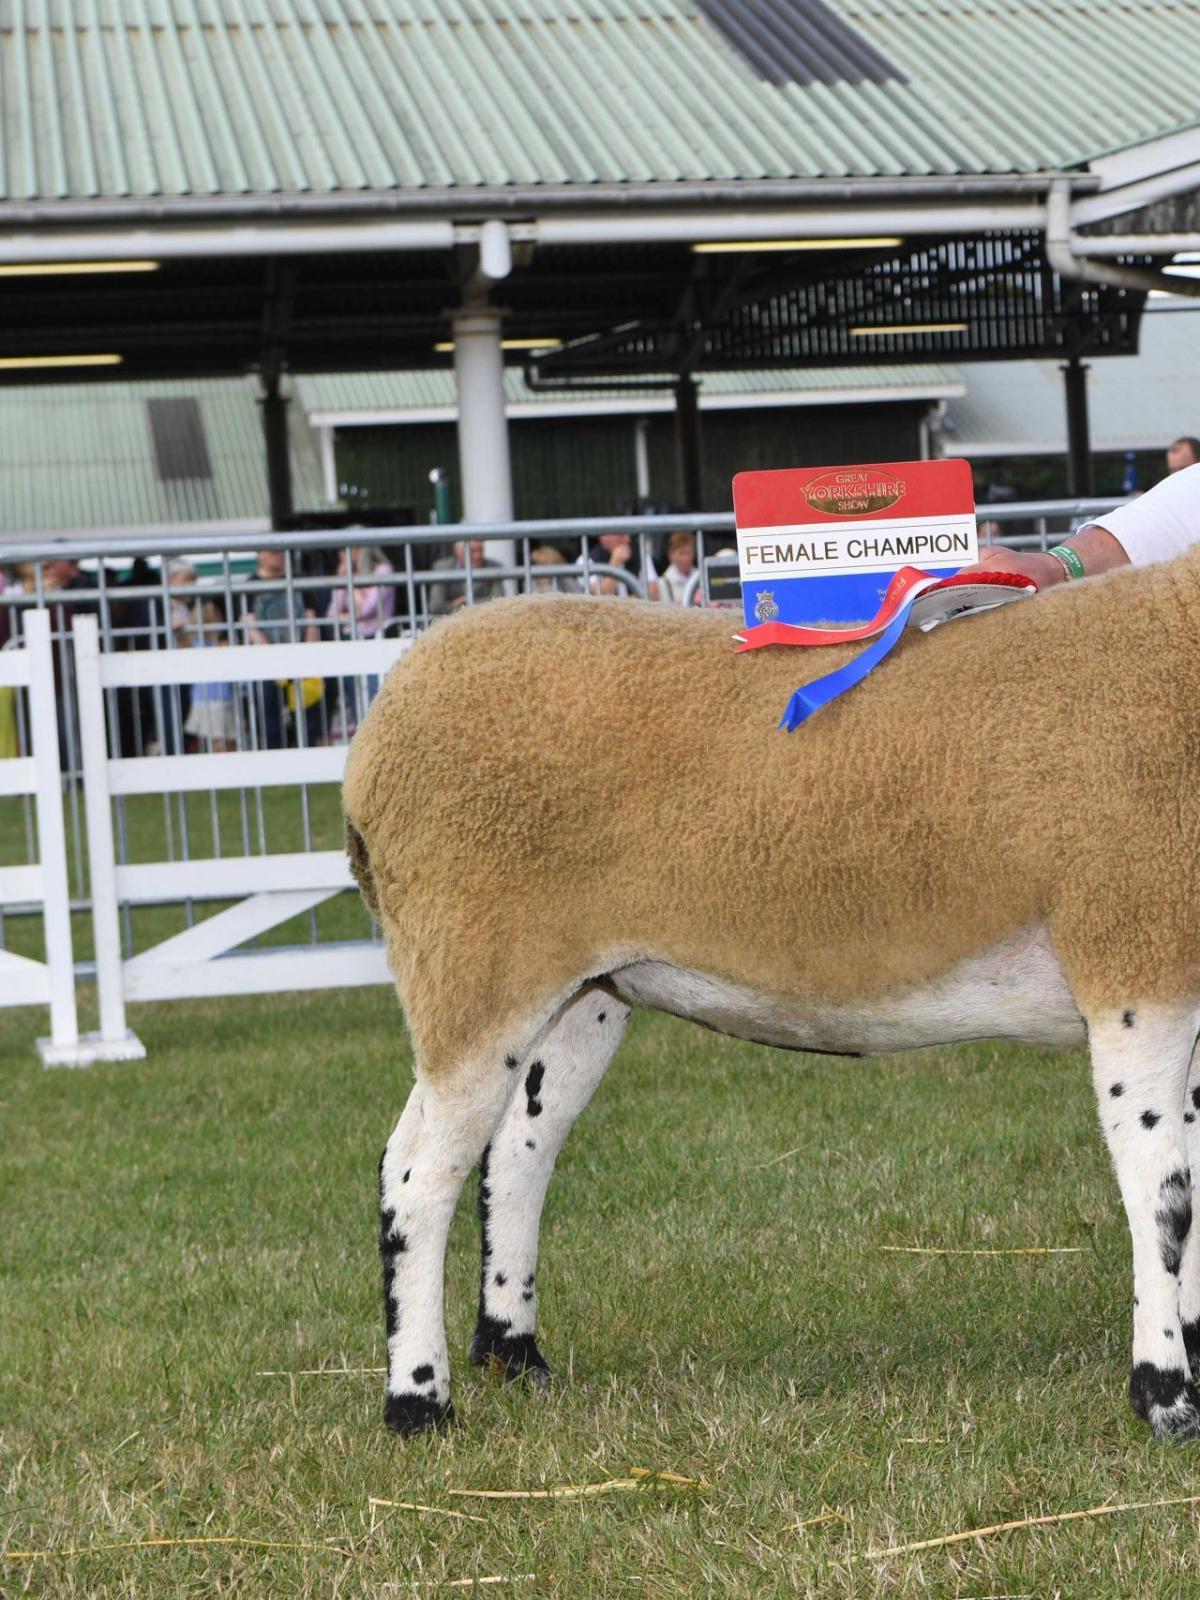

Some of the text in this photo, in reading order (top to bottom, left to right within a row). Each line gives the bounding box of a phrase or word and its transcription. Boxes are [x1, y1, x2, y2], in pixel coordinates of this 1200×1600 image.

[836, 473, 868, 484] GREAT
[800, 481, 907, 502] YORKSHIRE
[838, 499, 870, 511] SHOW
[746, 532, 969, 565] FEMALE CHAMPION
